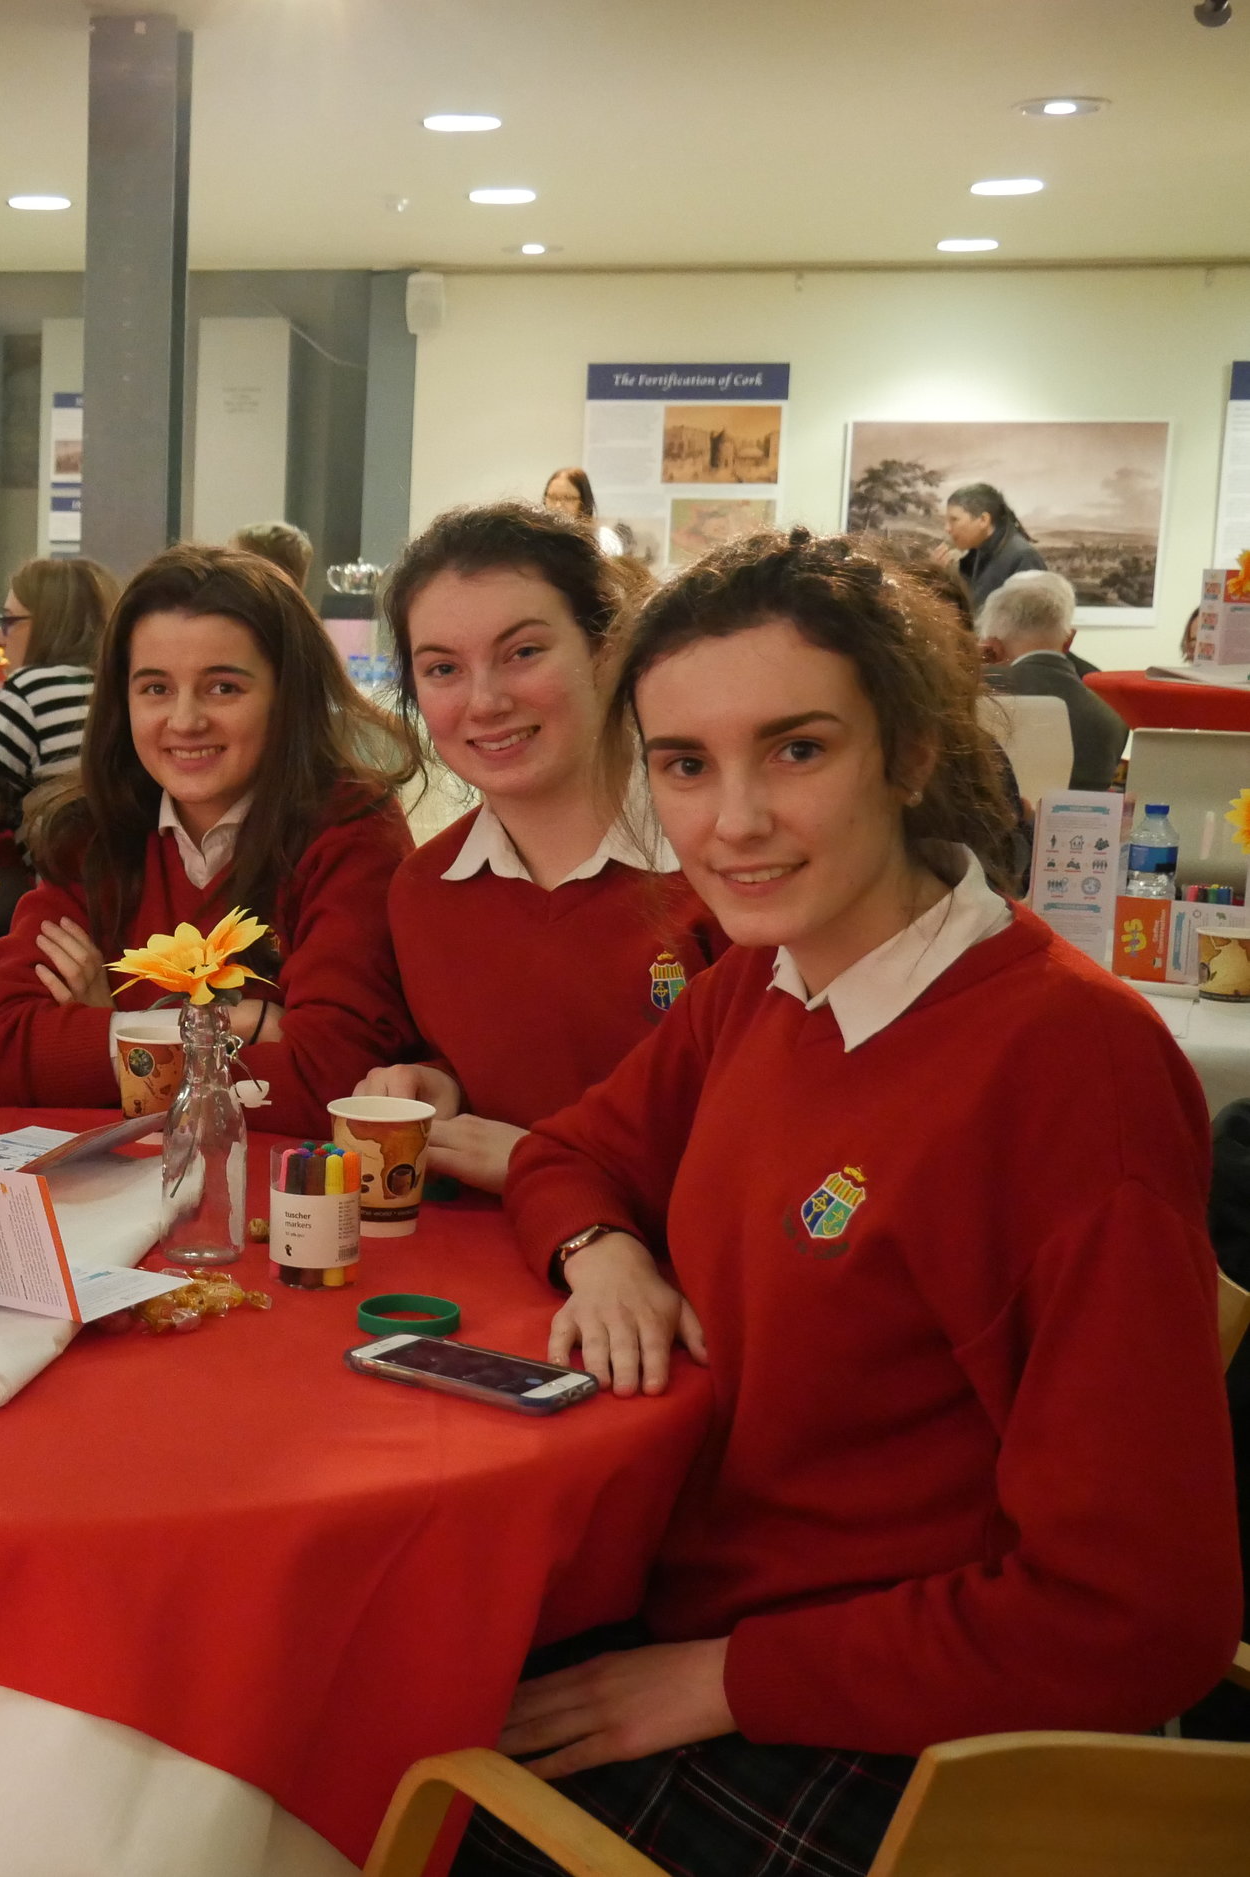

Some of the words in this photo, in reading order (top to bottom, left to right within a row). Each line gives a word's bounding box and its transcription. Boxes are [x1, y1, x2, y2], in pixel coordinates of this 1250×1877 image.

[613, 373, 635, 387] The
[638, 371, 716, 392] Fortification
[718, 372, 734, 392] of
[733, 371, 763, 387] Cork
[285, 1211, 311, 1220] tuscher
[285, 1221, 312, 1229] markers
